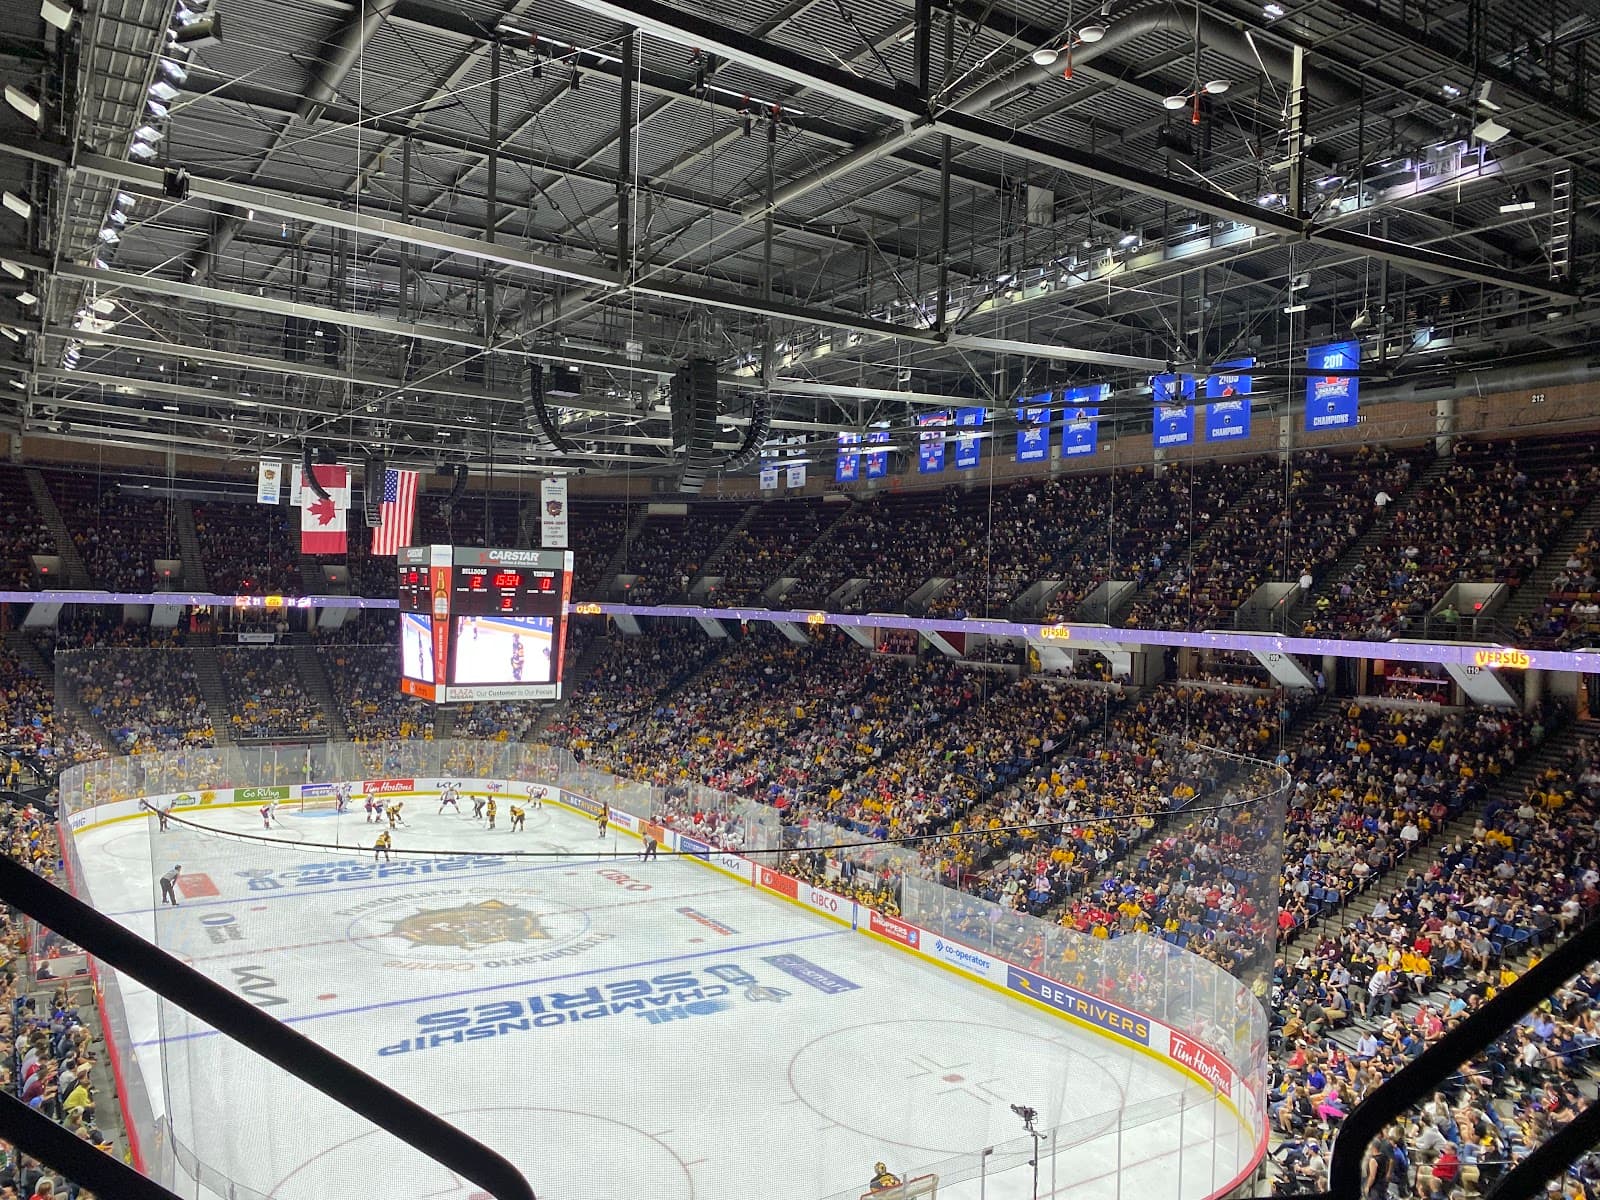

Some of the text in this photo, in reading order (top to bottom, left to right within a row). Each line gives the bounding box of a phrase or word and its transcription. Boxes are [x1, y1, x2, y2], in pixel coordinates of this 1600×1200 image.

[1324, 354, 1343, 369] 2011
[1531, 394, 1545, 402] 212
[1313, 414, 1349, 426] CHAMPIONS
[1160, 433, 1188, 443] CHAMPIONS
[1212, 426, 1243, 437] CHAMPIONS
[489, 550, 539, 561] CARSTAR
[473, 576, 482, 587] 2
[543, 578, 551, 589] 0
[504, 599, 511, 607] 3
[1477, 651, 1528, 667] VERSUS
[1467, 666, 1480, 674] 110
[364, 779, 413, 793] Tim Hortons
[243, 788, 280, 799] Go RVing
[570, 796, 602, 814] BETRIVERS
[722, 857, 740, 870] KIA
[296, 861, 506, 886] SERIES
[811, 891, 830, 909] CIBC
[872, 916, 908, 936] SHOPPERS
[945, 945, 990, 969] co-operators
[417, 970, 700, 1034] SERIES
[1041, 984, 1147, 1038] BETRIVERS
[377, 985, 730, 1057] CHAMPIONSHIP
[1171, 1037, 1231, 1093] Tim Hortons
